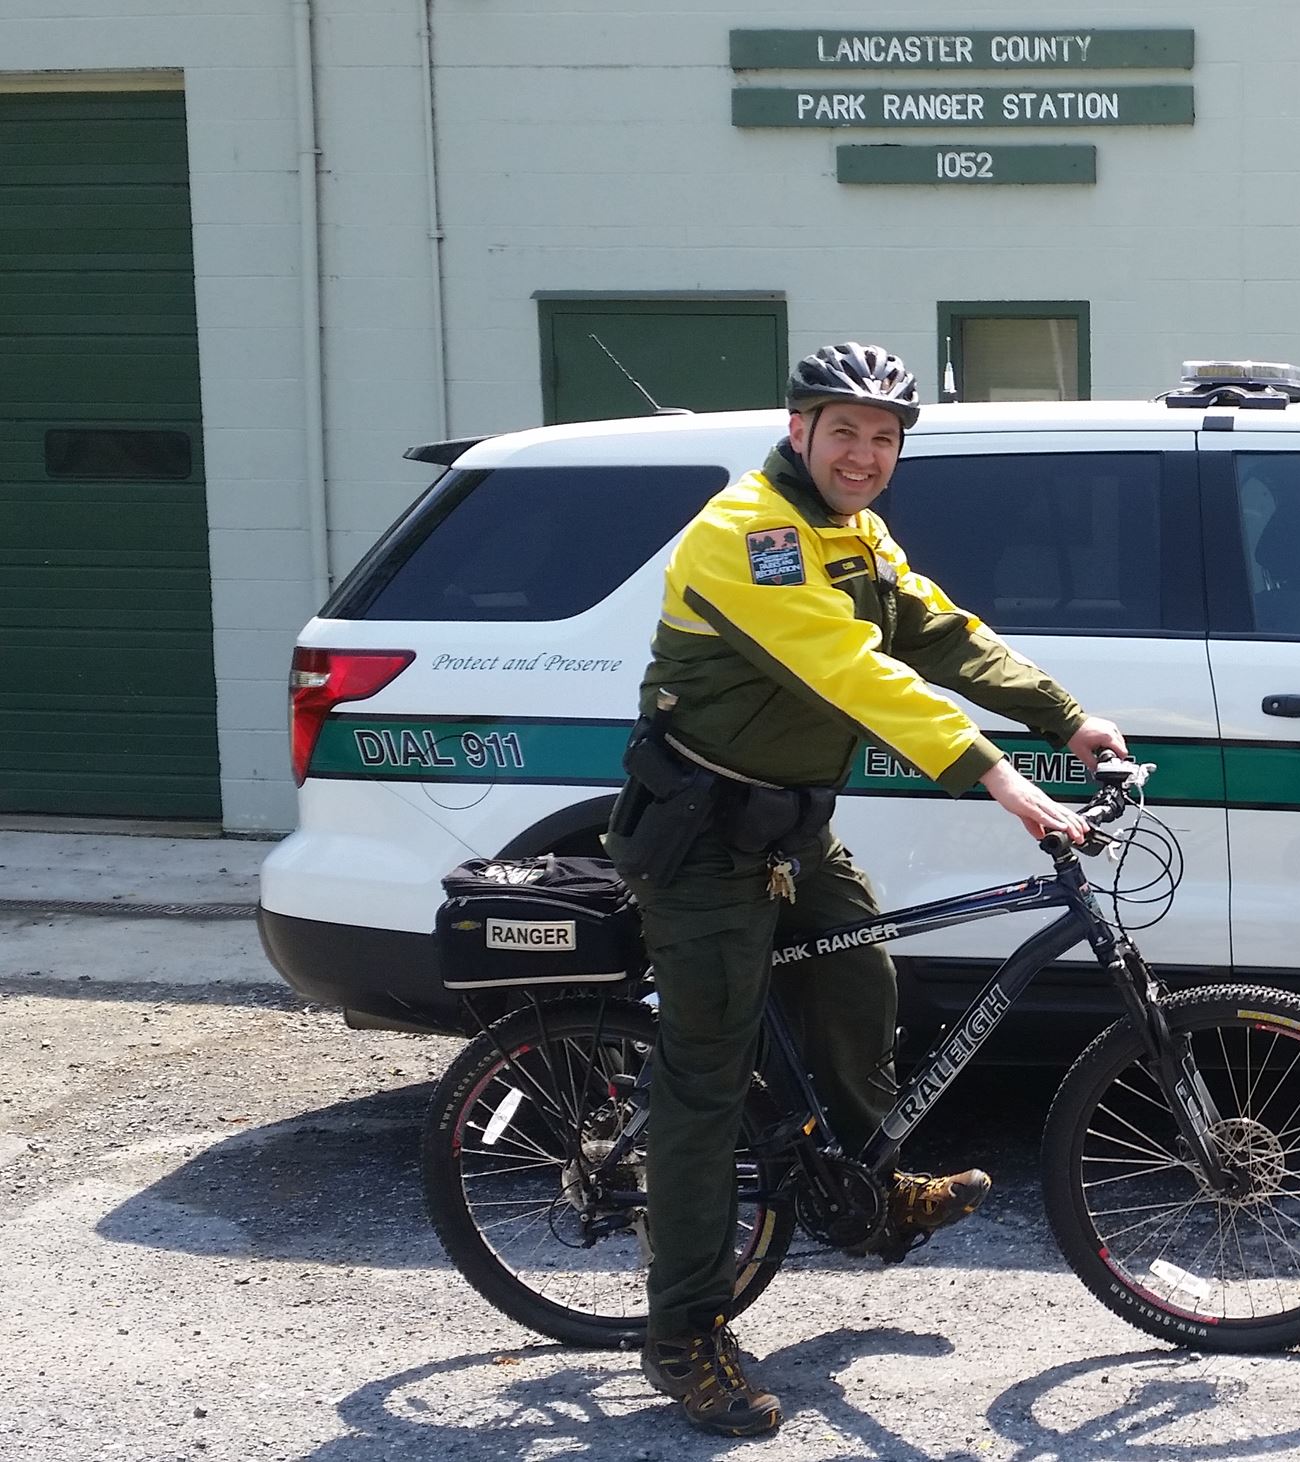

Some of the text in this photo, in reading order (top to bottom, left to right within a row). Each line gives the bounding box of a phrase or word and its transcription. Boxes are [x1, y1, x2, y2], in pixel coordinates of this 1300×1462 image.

[817, 35, 1092, 62] LANCASTER COUNTY
[797, 92, 1120, 120] PARK RANGER STATION
[936, 151, 994, 178] 1052
[431, 652, 623, 672] Protect and Preserve
[354, 729, 525, 768] DIAL 911
[492, 925, 570, 945] RANGER
[771, 922, 900, 967] ARK RANGER
[898, 983, 1011, 1125] RALEIGH
